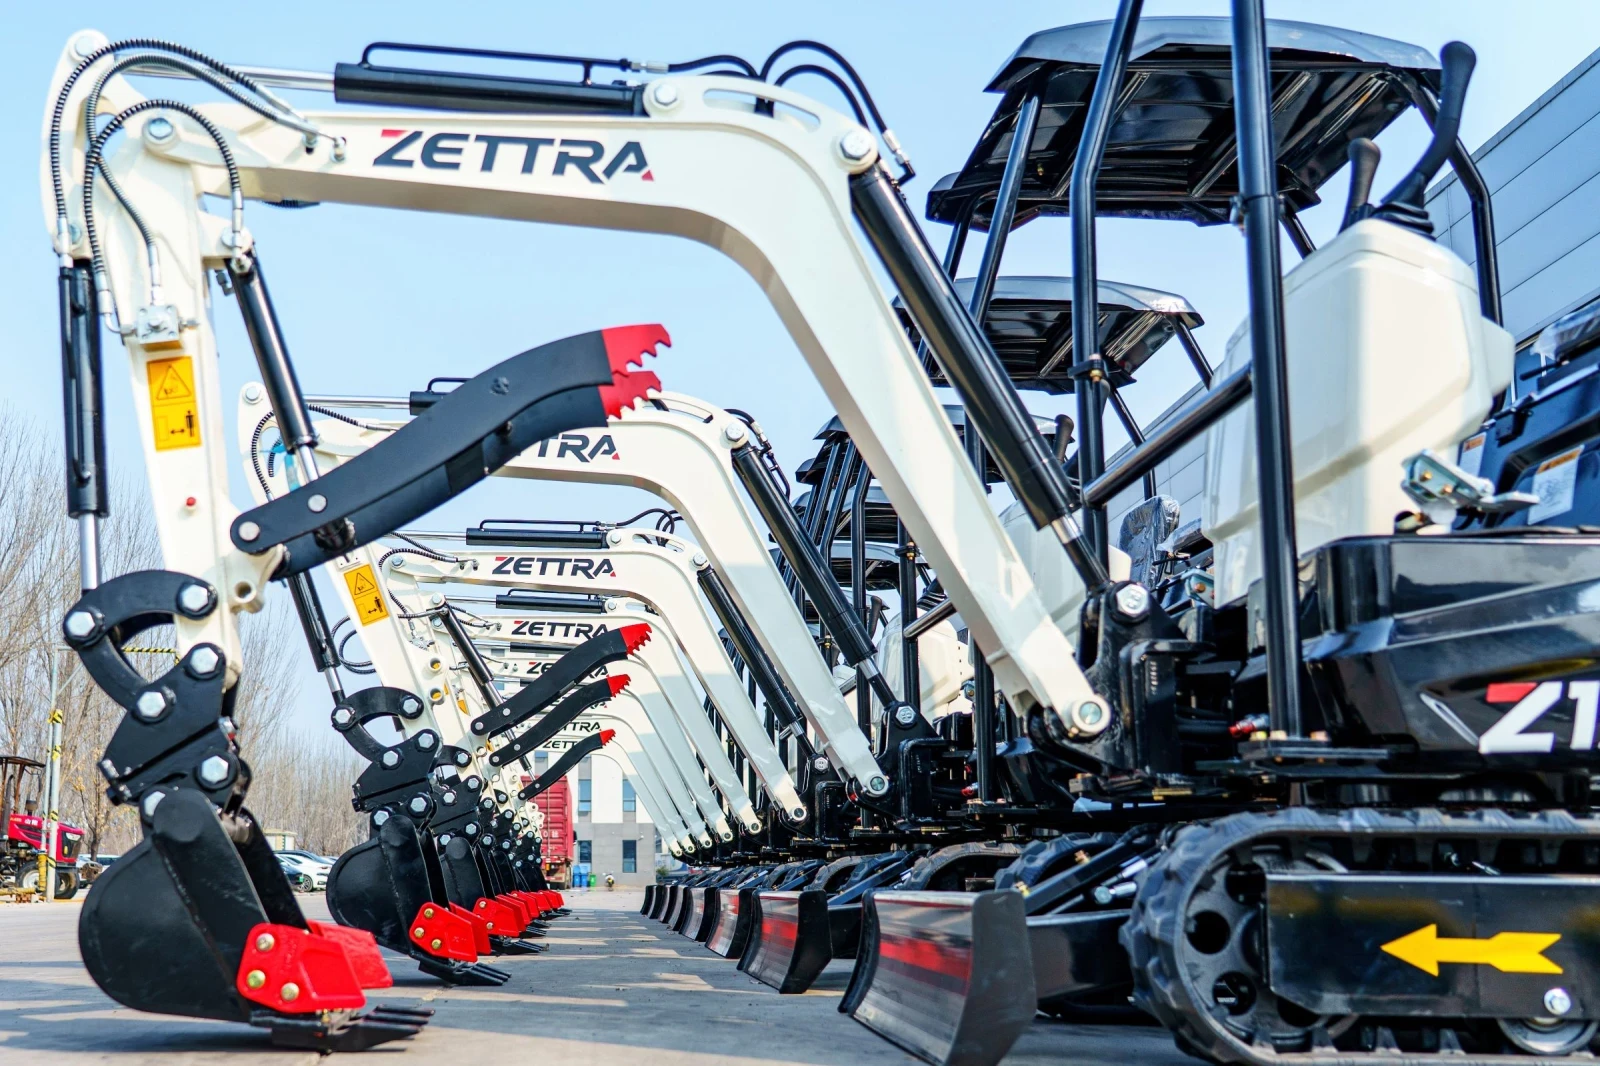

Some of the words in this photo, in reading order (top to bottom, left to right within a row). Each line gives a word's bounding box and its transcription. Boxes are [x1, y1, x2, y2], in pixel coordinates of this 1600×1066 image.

[373, 129, 654, 184] ZETTRA
[492, 556, 616, 579] ZETTRA
[511, 620, 609, 640] ZETTRA
[1478, 681, 1600, 754] Z1
